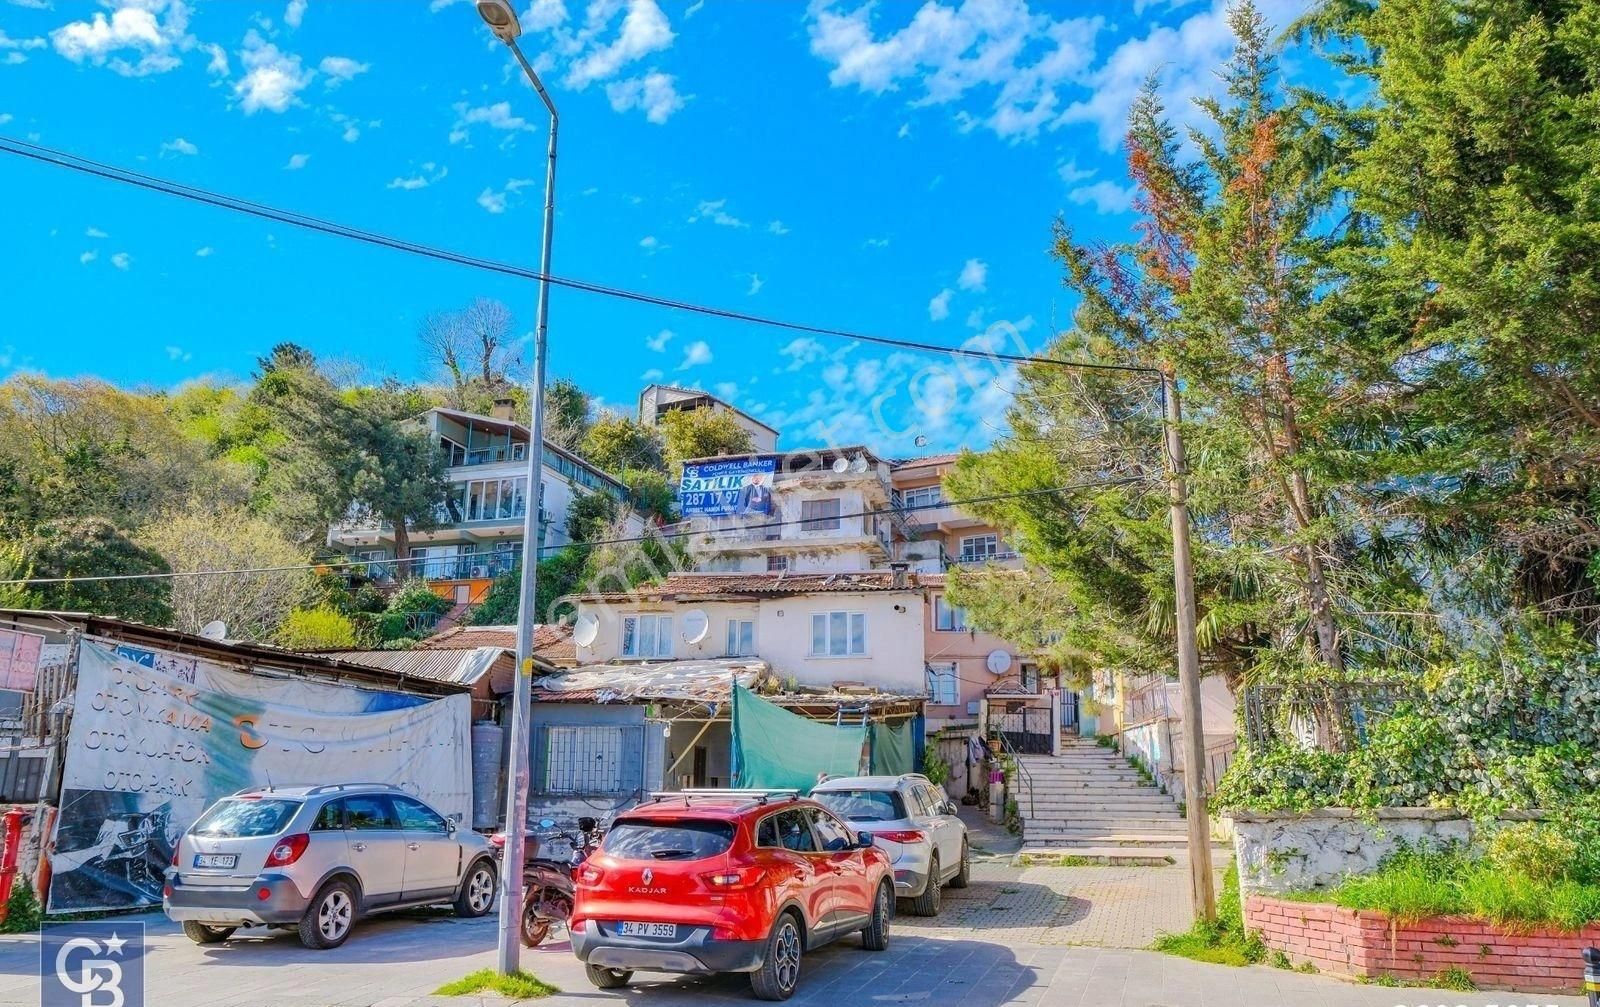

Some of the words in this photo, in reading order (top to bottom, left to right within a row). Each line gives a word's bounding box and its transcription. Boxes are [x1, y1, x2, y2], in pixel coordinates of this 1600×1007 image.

[703, 463, 742, 473] COLDWELL
[743, 460, 773, 469] BANKER
[682, 475, 745, 491] SATILIK
[685, 492, 706, 506] 287
[710, 492, 722, 505] 17
[725, 490, 739, 503] 97
[628, 886, 667, 894] KADJAR
[623, 922, 634, 934] 34
[637, 923, 649, 935] PV
[652, 924, 674, 937] 3559
